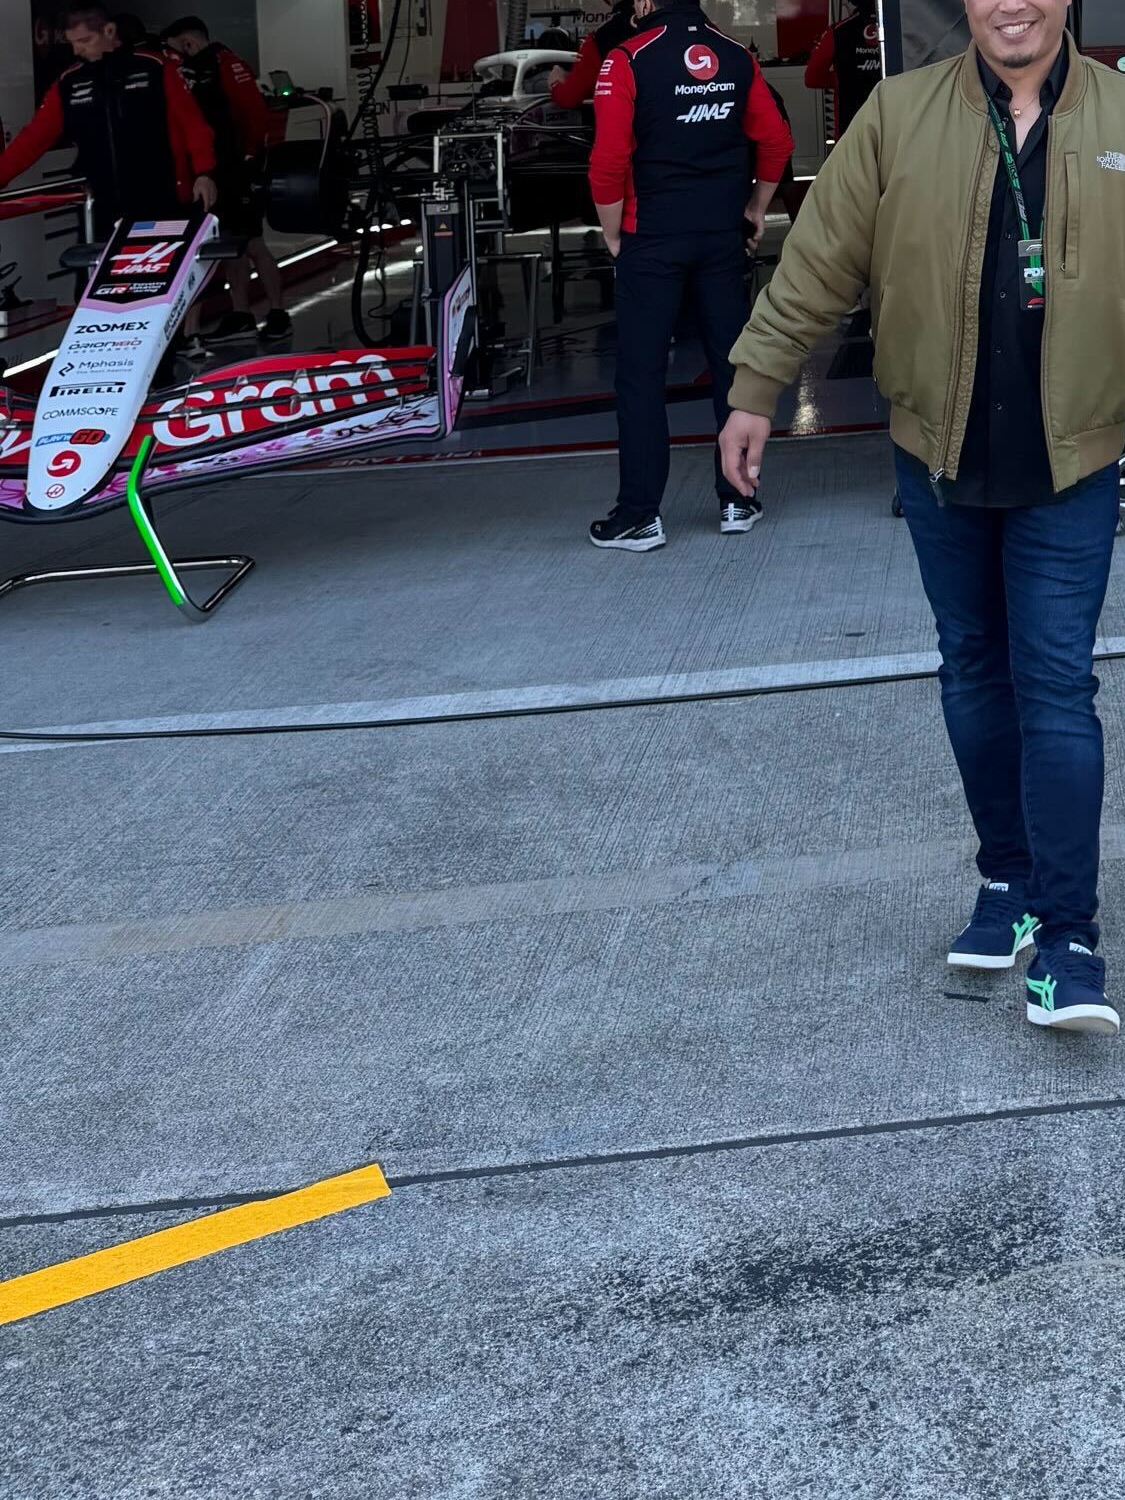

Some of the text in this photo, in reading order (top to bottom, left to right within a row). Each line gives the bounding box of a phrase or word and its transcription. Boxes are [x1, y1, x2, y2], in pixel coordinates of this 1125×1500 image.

[675, 82, 735, 95] MoneyGram
[676, 102, 734, 123] HAAS
[75, 321, 150, 334] ZOOMEX
[79, 359, 134, 369] Mphasis
[49, 382, 126, 397] PIRELLI
[42, 407, 120, 420] COMMSCOPE
